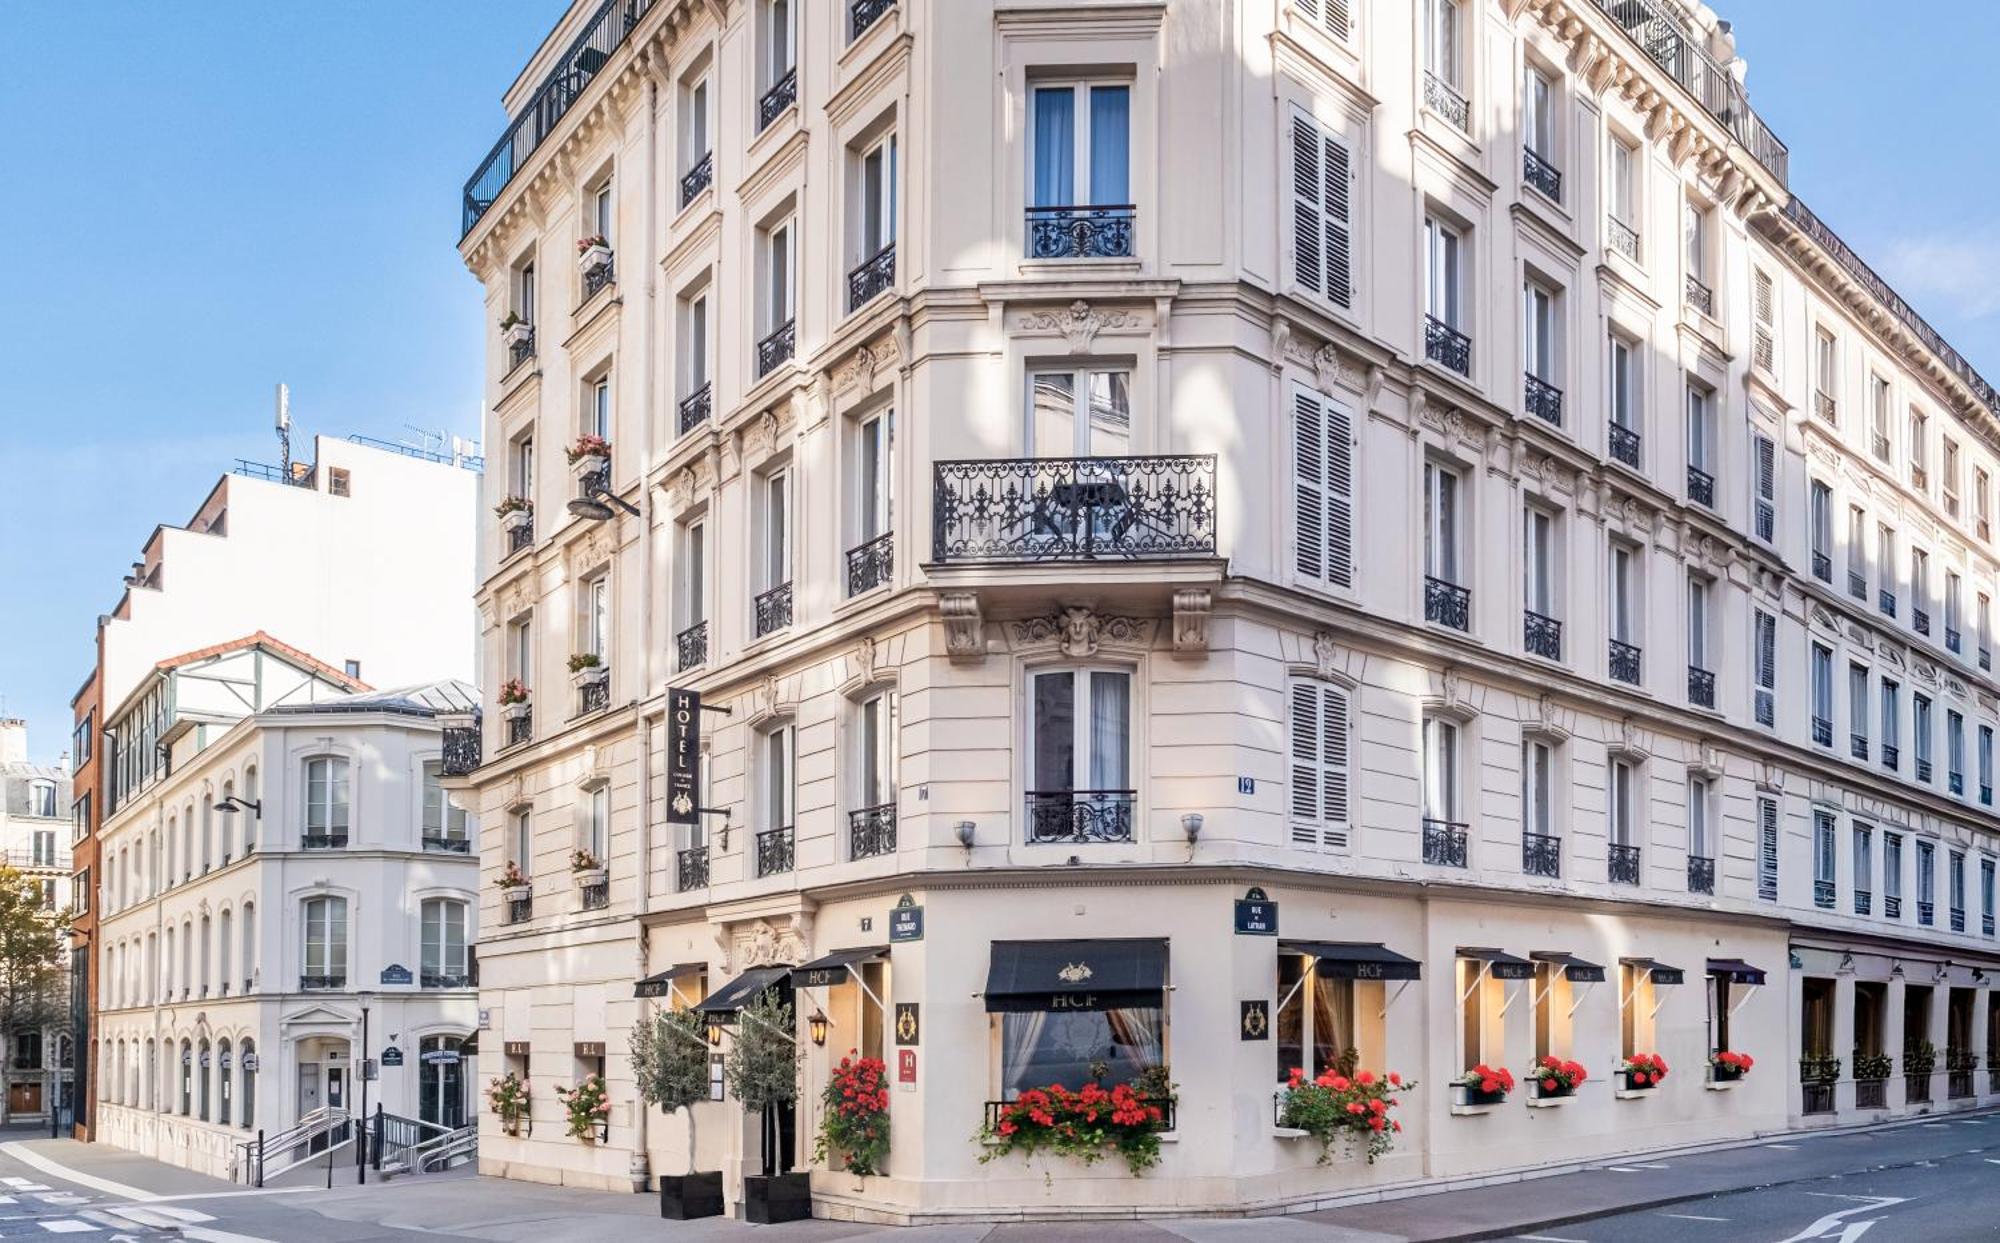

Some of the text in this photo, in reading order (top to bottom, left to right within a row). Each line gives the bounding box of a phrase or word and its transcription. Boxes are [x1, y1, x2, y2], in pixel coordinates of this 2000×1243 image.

[677, 695, 690, 768] HOTEL
[1241, 778, 1251, 793] 12
[1251, 906, 1262, 914] RUE
[809, 970, 830, 984] HCF
[1357, 964, 1382, 977] HCF
[644, 983, 660, 995] HCF
[1052, 994, 1097, 1008] HCF
[905, 1054, 913, 1068] H
